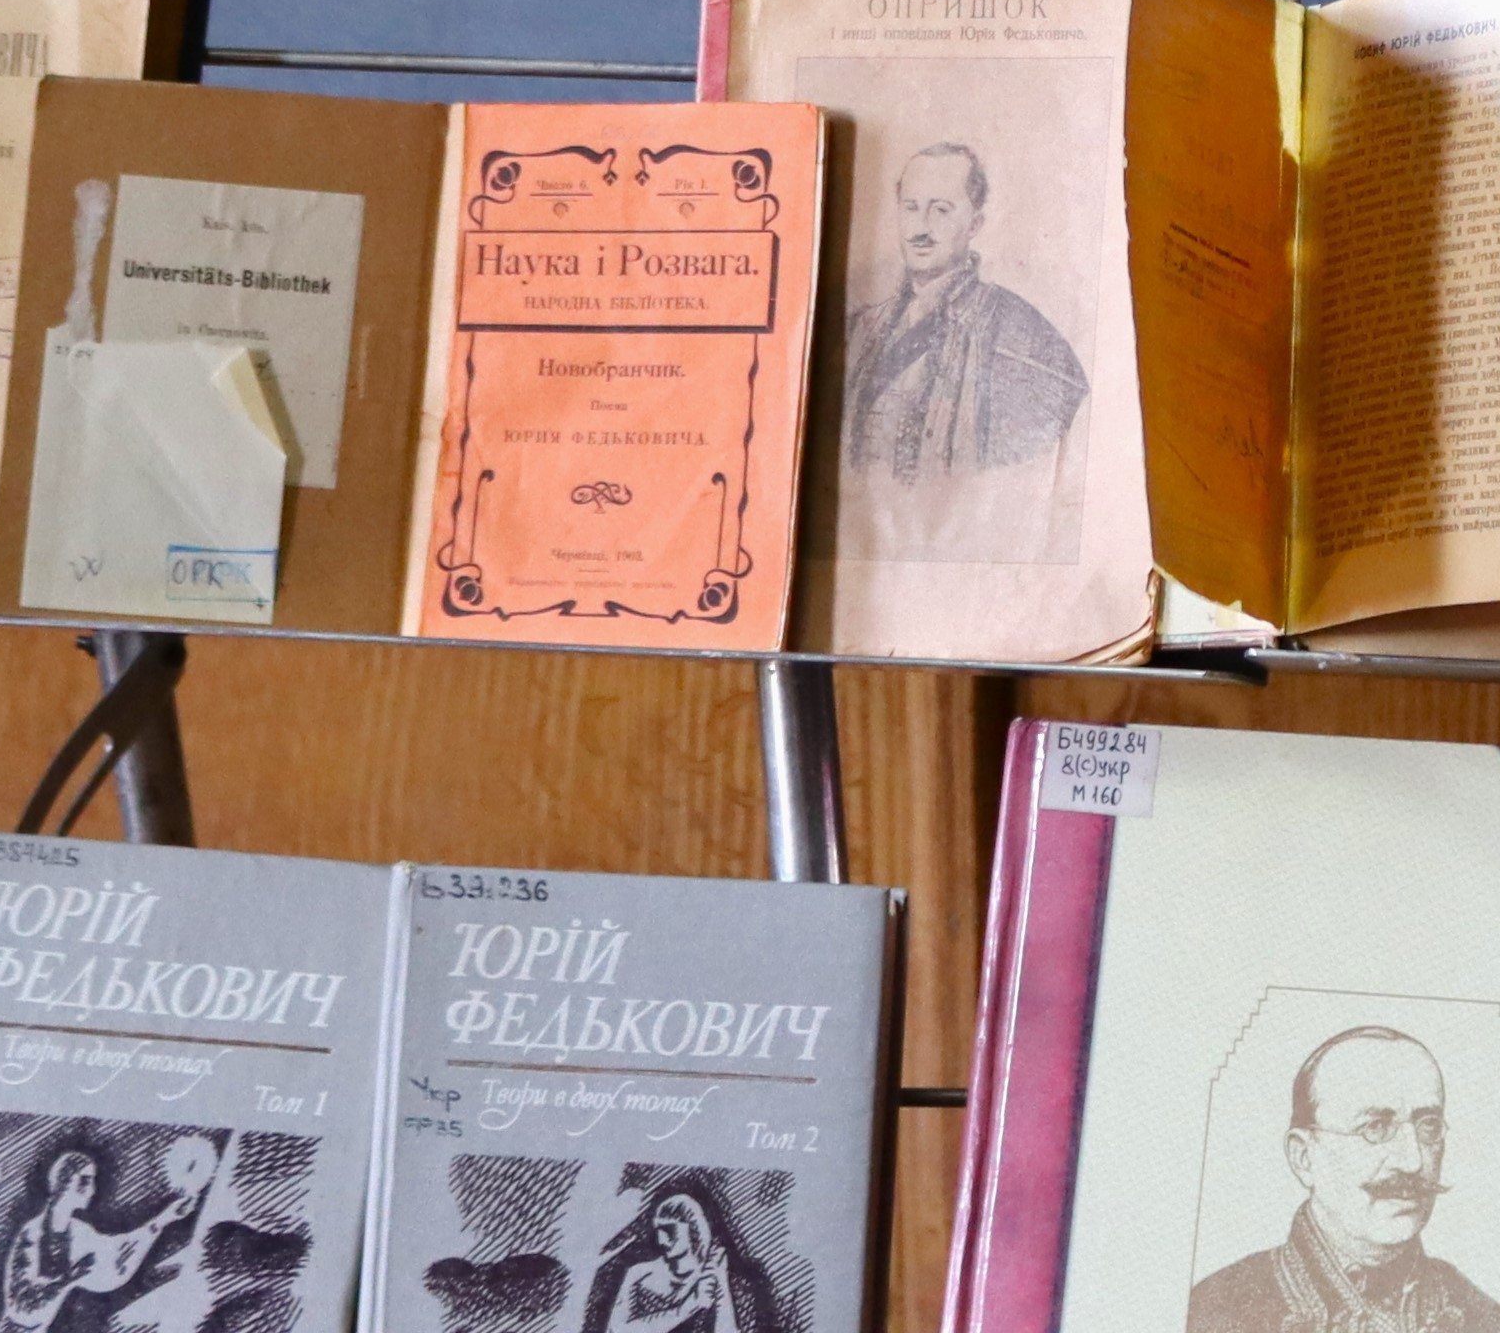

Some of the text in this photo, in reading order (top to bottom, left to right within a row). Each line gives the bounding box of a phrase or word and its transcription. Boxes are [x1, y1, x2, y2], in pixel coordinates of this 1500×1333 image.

[123, 259, 331, 295] Universitäts-Bibliothek
[476, 244, 759, 285] Наука і Розвага.
[538, 358, 686, 382] Новобранчик.
[448, 918, 631, 986] ЮРІЙ
[445, 989, 831, 1064] ФЕДЬКОВИЧ
[254, 1084, 329, 1116] Том 1
[745, 1121, 819, 1152] Том 2
